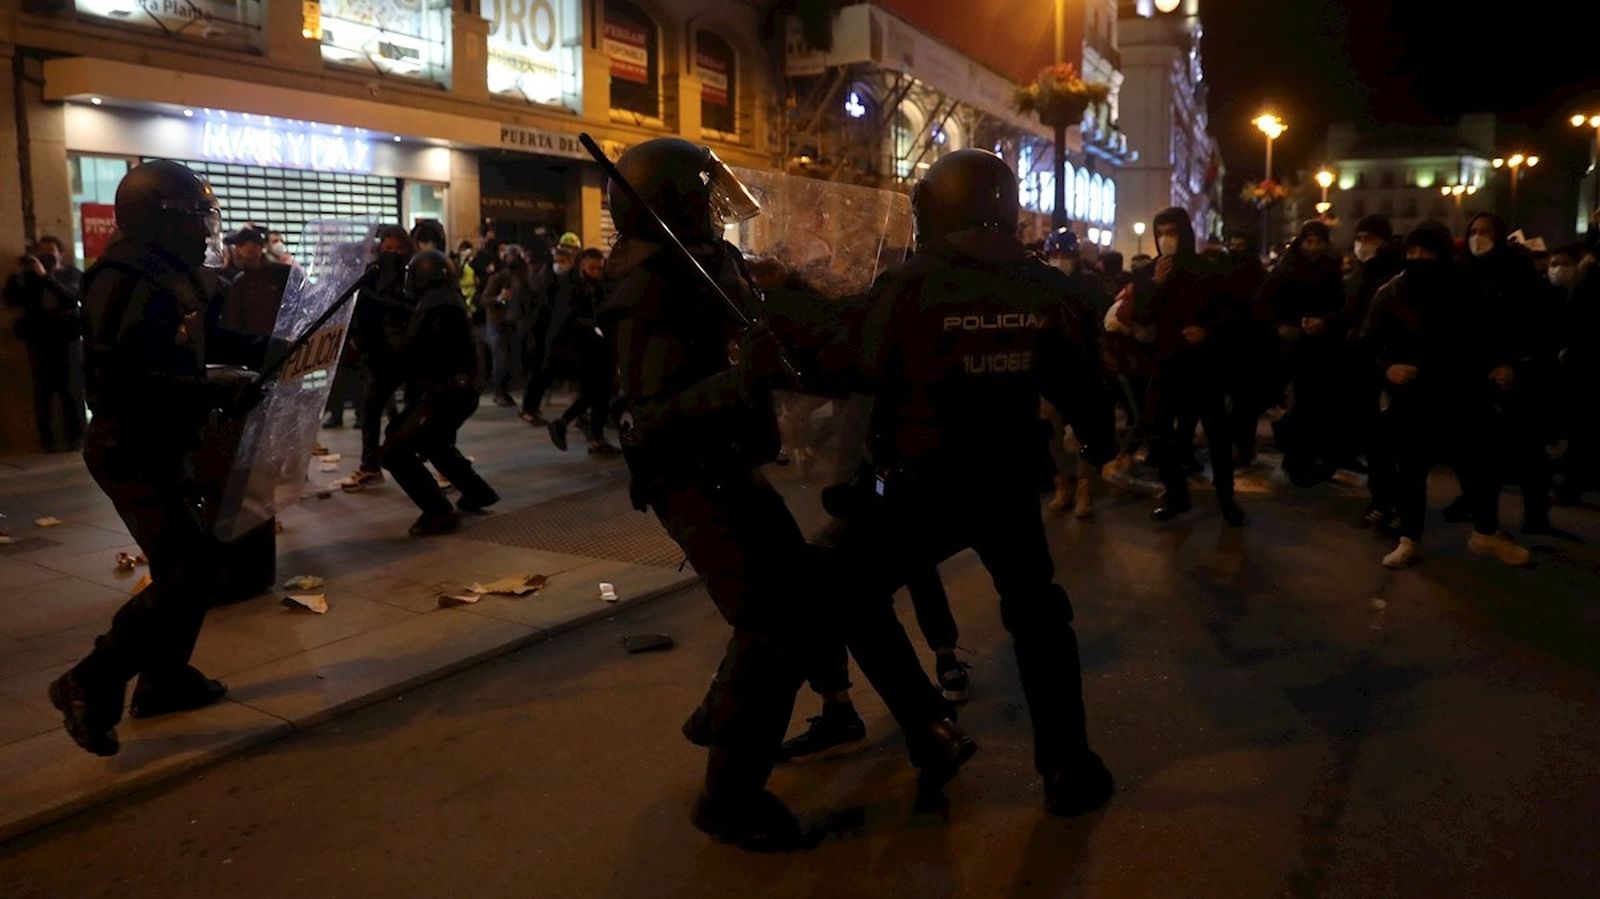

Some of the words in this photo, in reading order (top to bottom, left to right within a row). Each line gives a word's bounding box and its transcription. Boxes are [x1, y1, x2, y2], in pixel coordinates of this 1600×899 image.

[202, 122, 282, 163] MAR
[500, 129, 553, 149] PUERTA
[560, 138, 582, 153] DEL
[943, 313, 1038, 331] POLICIA
